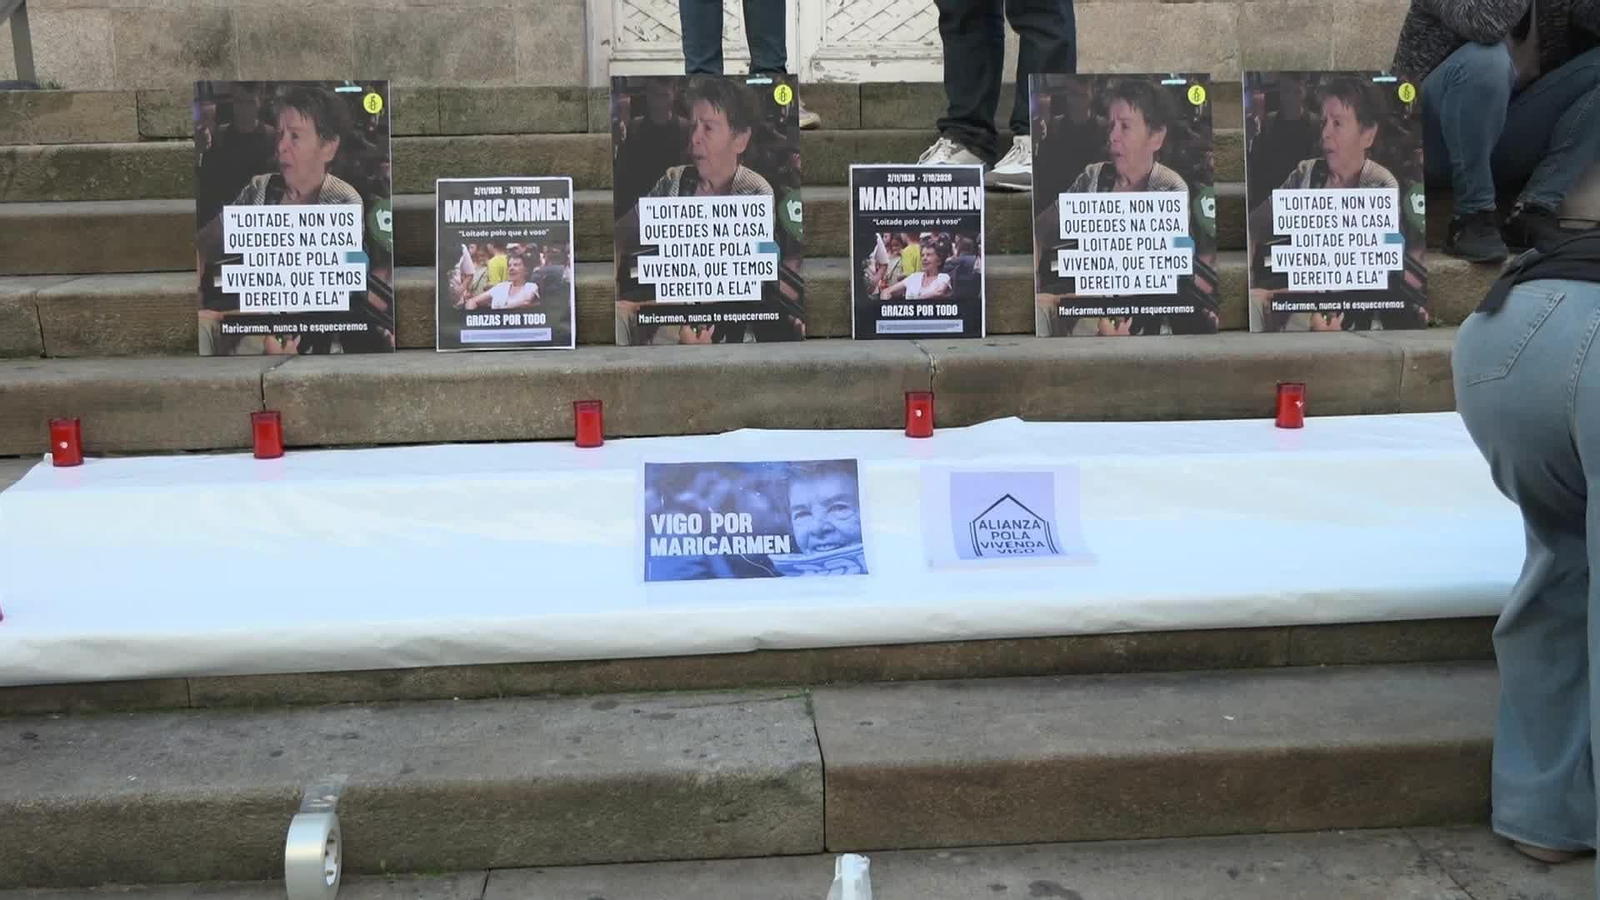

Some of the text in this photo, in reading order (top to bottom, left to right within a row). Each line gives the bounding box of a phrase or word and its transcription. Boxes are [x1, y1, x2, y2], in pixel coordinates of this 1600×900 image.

[859, 186, 981, 211] MARICARMEN
[1279, 196, 1391, 212] "LOITADE, NON VOS
[445, 198, 570, 223] MARICARMEN
[646, 203, 766, 220] "LOITADE, NON VOS
[1066, 200, 1181, 215] "LOITADE, NON VOS
[231, 212, 354, 228] "LOITADE, NON VOS
[904, 218, 920, 227] polo
[921, 219, 934, 227] que
[936, 217, 940, 225] é
[1065, 218, 1184, 234] QUEDEDES NA CASA,
[1278, 214, 1394, 230] QUEDEDES NA CASA,
[490, 229, 507, 238] polo
[508, 229, 522, 238] que
[644, 223, 769, 239] QUEDEDES NA CASA,
[229, 232, 357, 248] QUEDEDES NA CASA,
[1083, 237, 1167, 252] LOITADE POLA
[1296, 233, 1378, 247] LOITADE POLA
[664, 242, 751, 258] LOITADE POLA
[249, 252, 339, 266] LOITADE POLA
[1063, 256, 1188, 271] VIVENDA, QUE TEMOS
[1276, 251, 1398, 267] VIVENDA, QUE TEMOS
[642, 261, 773, 278] VIVENDA, QUE TEMOS
[227, 271, 362, 287] VIVENDA, QUE TEMOS
[1080, 275, 1173, 289] DEREITO A ELA"
[1293, 270, 1383, 285] DEREITO A ELA"
[660, 281, 757, 297] DEREITO A ELA"
[245, 291, 345, 306] DEREITO A ELA"
[1272, 301, 1404, 311] Maricarmen, nunca te esqueceremos
[881, 304, 958, 317] GRAZAS POR TODO
[1059, 307, 1105, 316] Maricarmen,
[1131, 306, 1139, 314] te
[1140, 306, 1195, 314] esqueceremos
[466, 313, 546, 327] GRAZAS POR TODO
[638, 313, 780, 324] Maricarmen, nunca te esqueceremos
[222, 322, 368, 334] Maricarmen, nunca te esqueceremos
[650, 512, 753, 535] VIGO POR
[979, 520, 1041, 530] ALIANZA
[991, 531, 1030, 540] POLA
[650, 535, 791, 557] MARICARMEN
[980, 541, 1045, 549] VIVENDA
